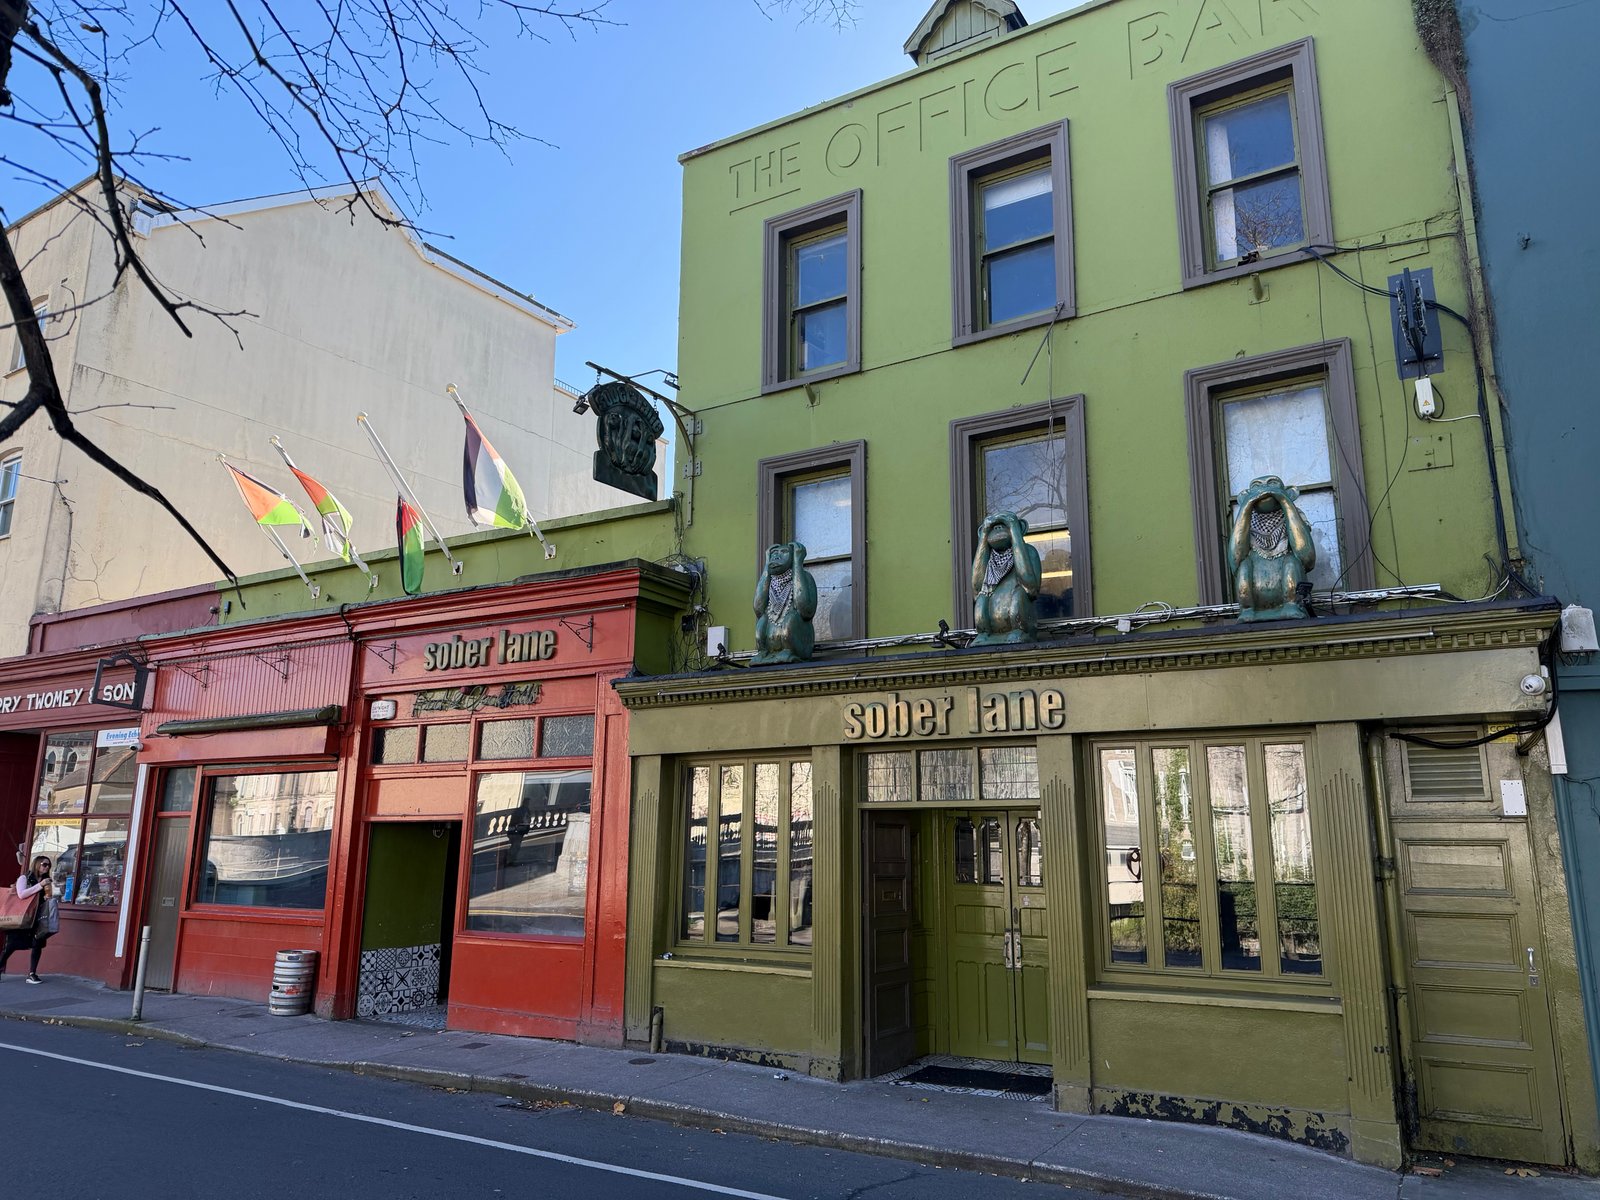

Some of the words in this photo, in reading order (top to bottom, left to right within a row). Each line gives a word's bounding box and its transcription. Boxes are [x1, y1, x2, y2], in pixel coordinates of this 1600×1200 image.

[729, 141, 801, 199] THE
[825, 42, 1080, 178] OFFICE
[423, 634, 495, 671] sober
[497, 629, 558, 664] lane
[0, 695, 21, 713] RY
[26, 687, 84, 711] TWOMEY
[102, 681, 136, 702] SON
[842, 692, 955, 739] sober
[966, 686, 1066, 733] lane
